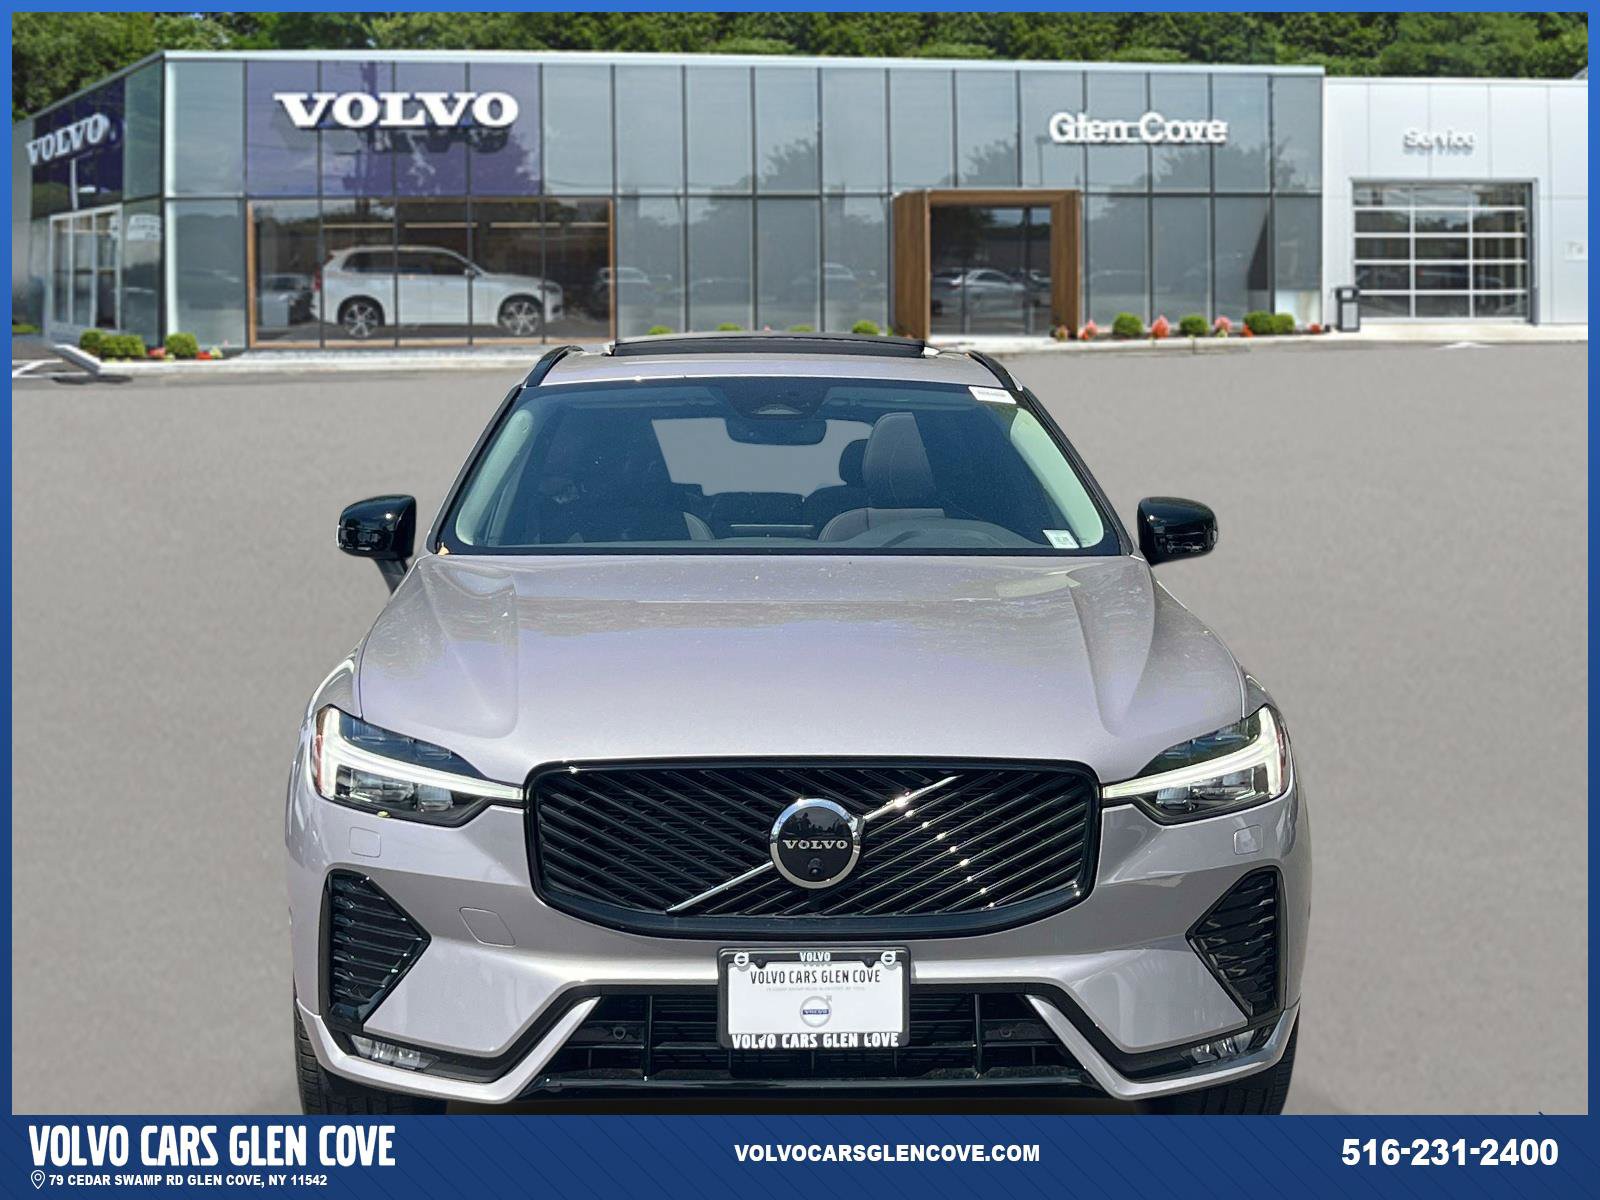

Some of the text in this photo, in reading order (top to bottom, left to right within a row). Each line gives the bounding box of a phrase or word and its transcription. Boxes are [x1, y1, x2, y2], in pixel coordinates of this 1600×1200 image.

[273, 92, 519, 128] VOLVO
[1049, 111, 1228, 143] Glen Cove
[26, 112, 111, 166] VOLVO
[1402, 127, 1475, 152] Service
[782, 839, 848, 850] VOLVO
[799, 951, 831, 962] VOLVO
[750, 969, 881, 985] VOLVO CARS GLEN COVE
[731, 1032, 899, 1049] VOLVO CARS GLEN COVE
